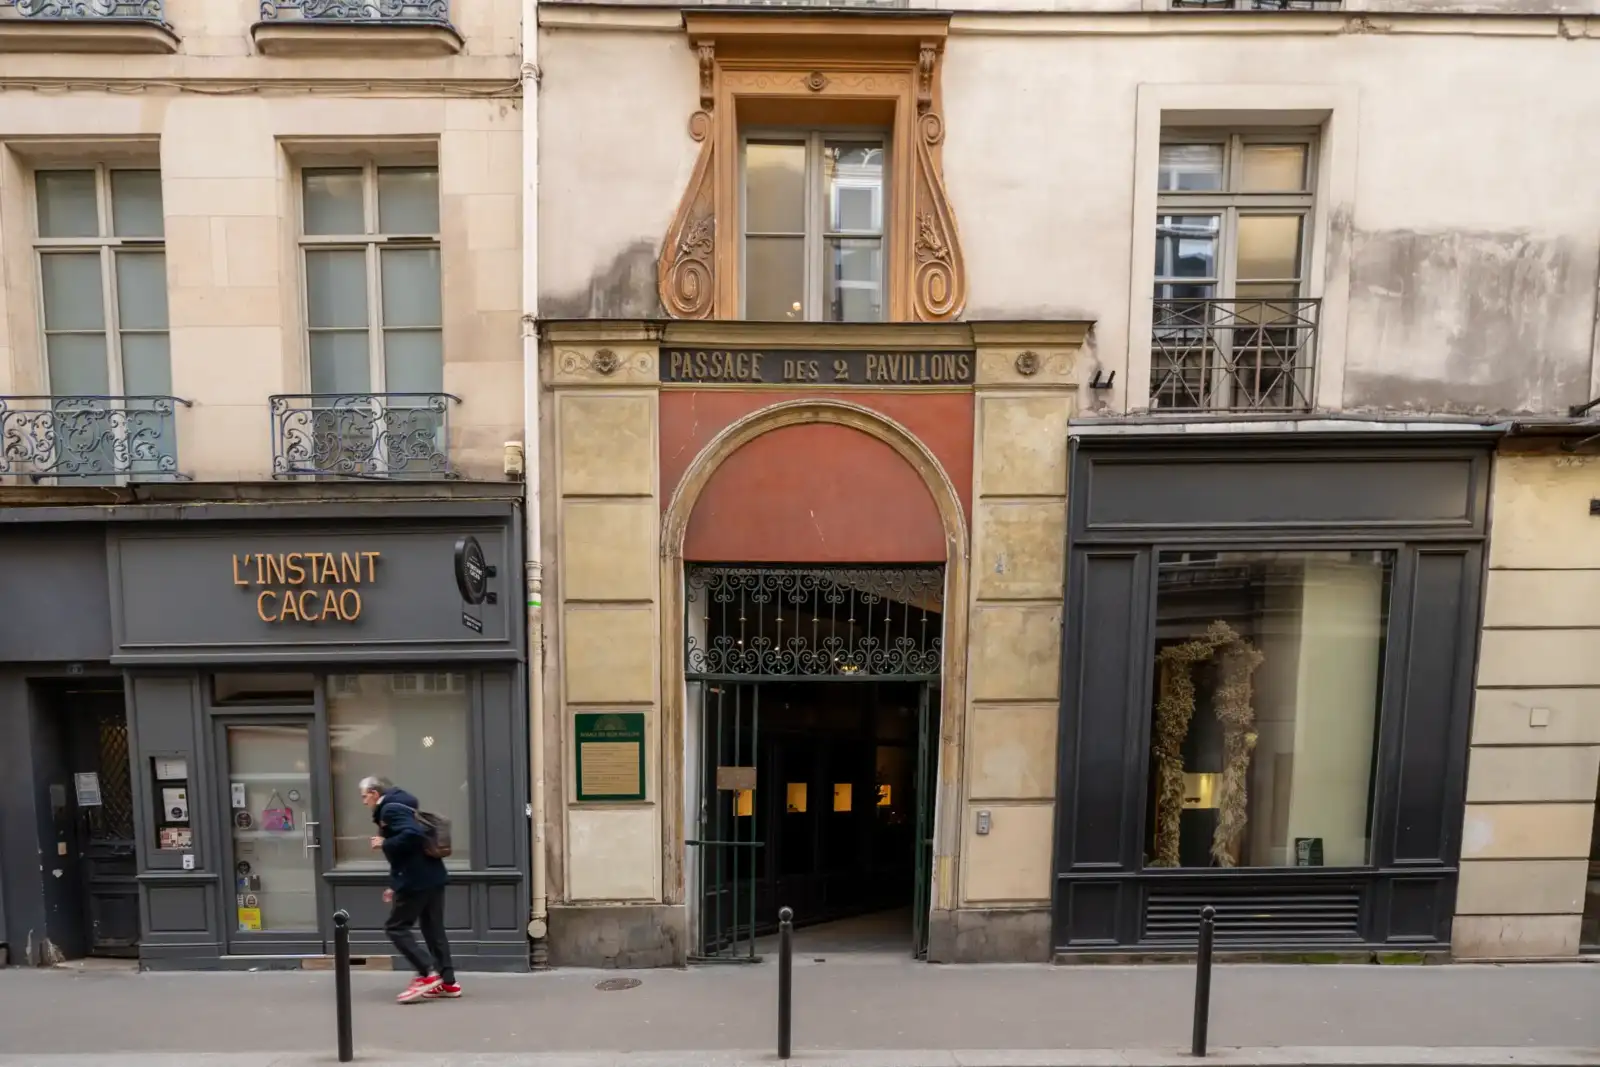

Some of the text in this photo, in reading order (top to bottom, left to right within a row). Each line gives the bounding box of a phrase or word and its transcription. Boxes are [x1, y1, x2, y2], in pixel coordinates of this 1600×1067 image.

[670, 351, 970, 382] PASSAGE DES 2 PAVILLONS
[232, 551, 381, 585] L'INSTANT
[257, 588, 362, 622] CACAO
